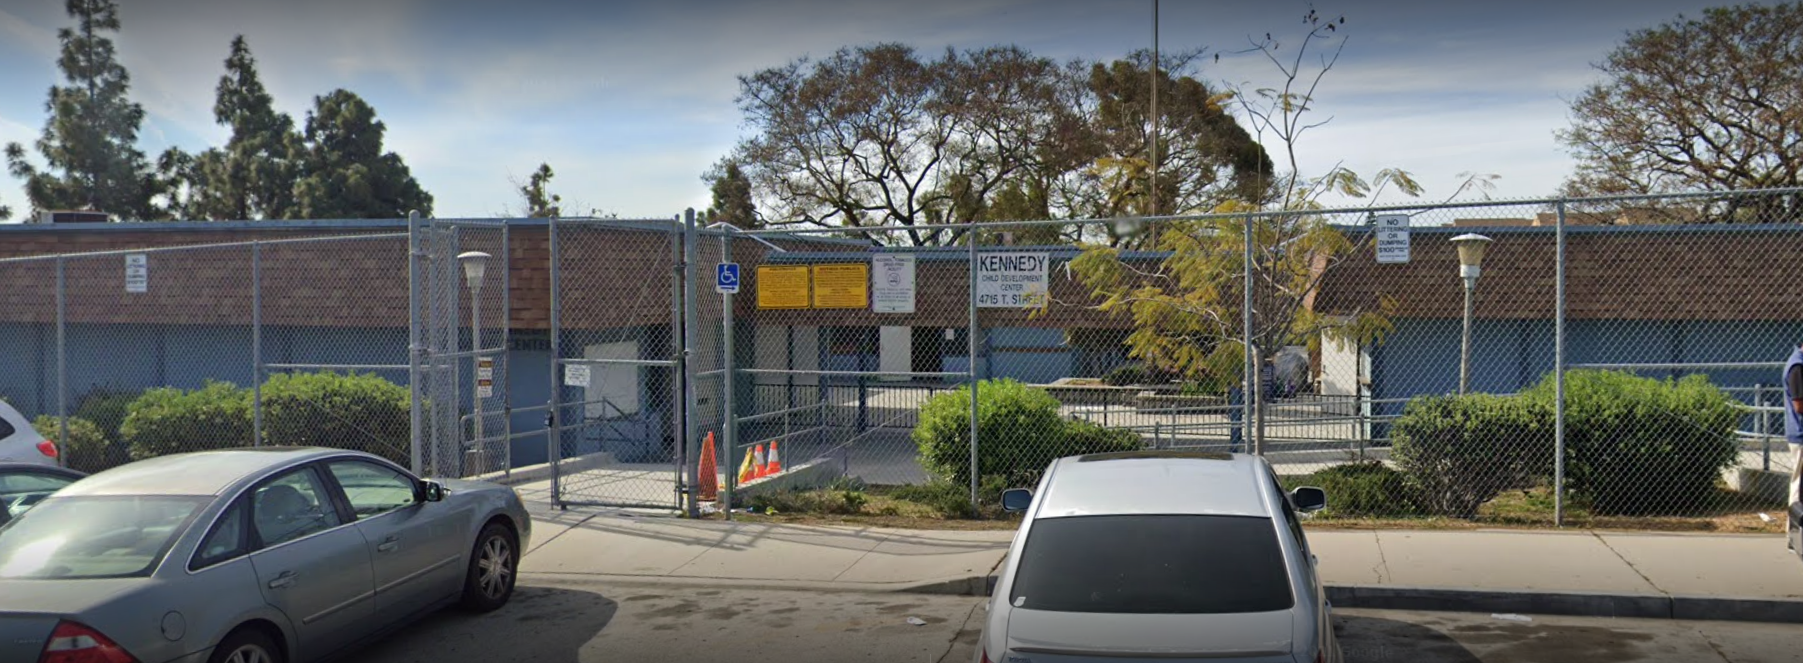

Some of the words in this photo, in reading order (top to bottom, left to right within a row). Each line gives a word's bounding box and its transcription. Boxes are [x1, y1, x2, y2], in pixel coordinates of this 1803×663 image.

[1386, 218, 1399, 226] NO
[979, 255, 1046, 272] KENNEDY
[981, 274, 999, 282] CHILD
[1001, 274, 1043, 282] DEVELOPMENT
[1000, 283, 1023, 291] CENTER
[978, 294, 998, 305] 4715
